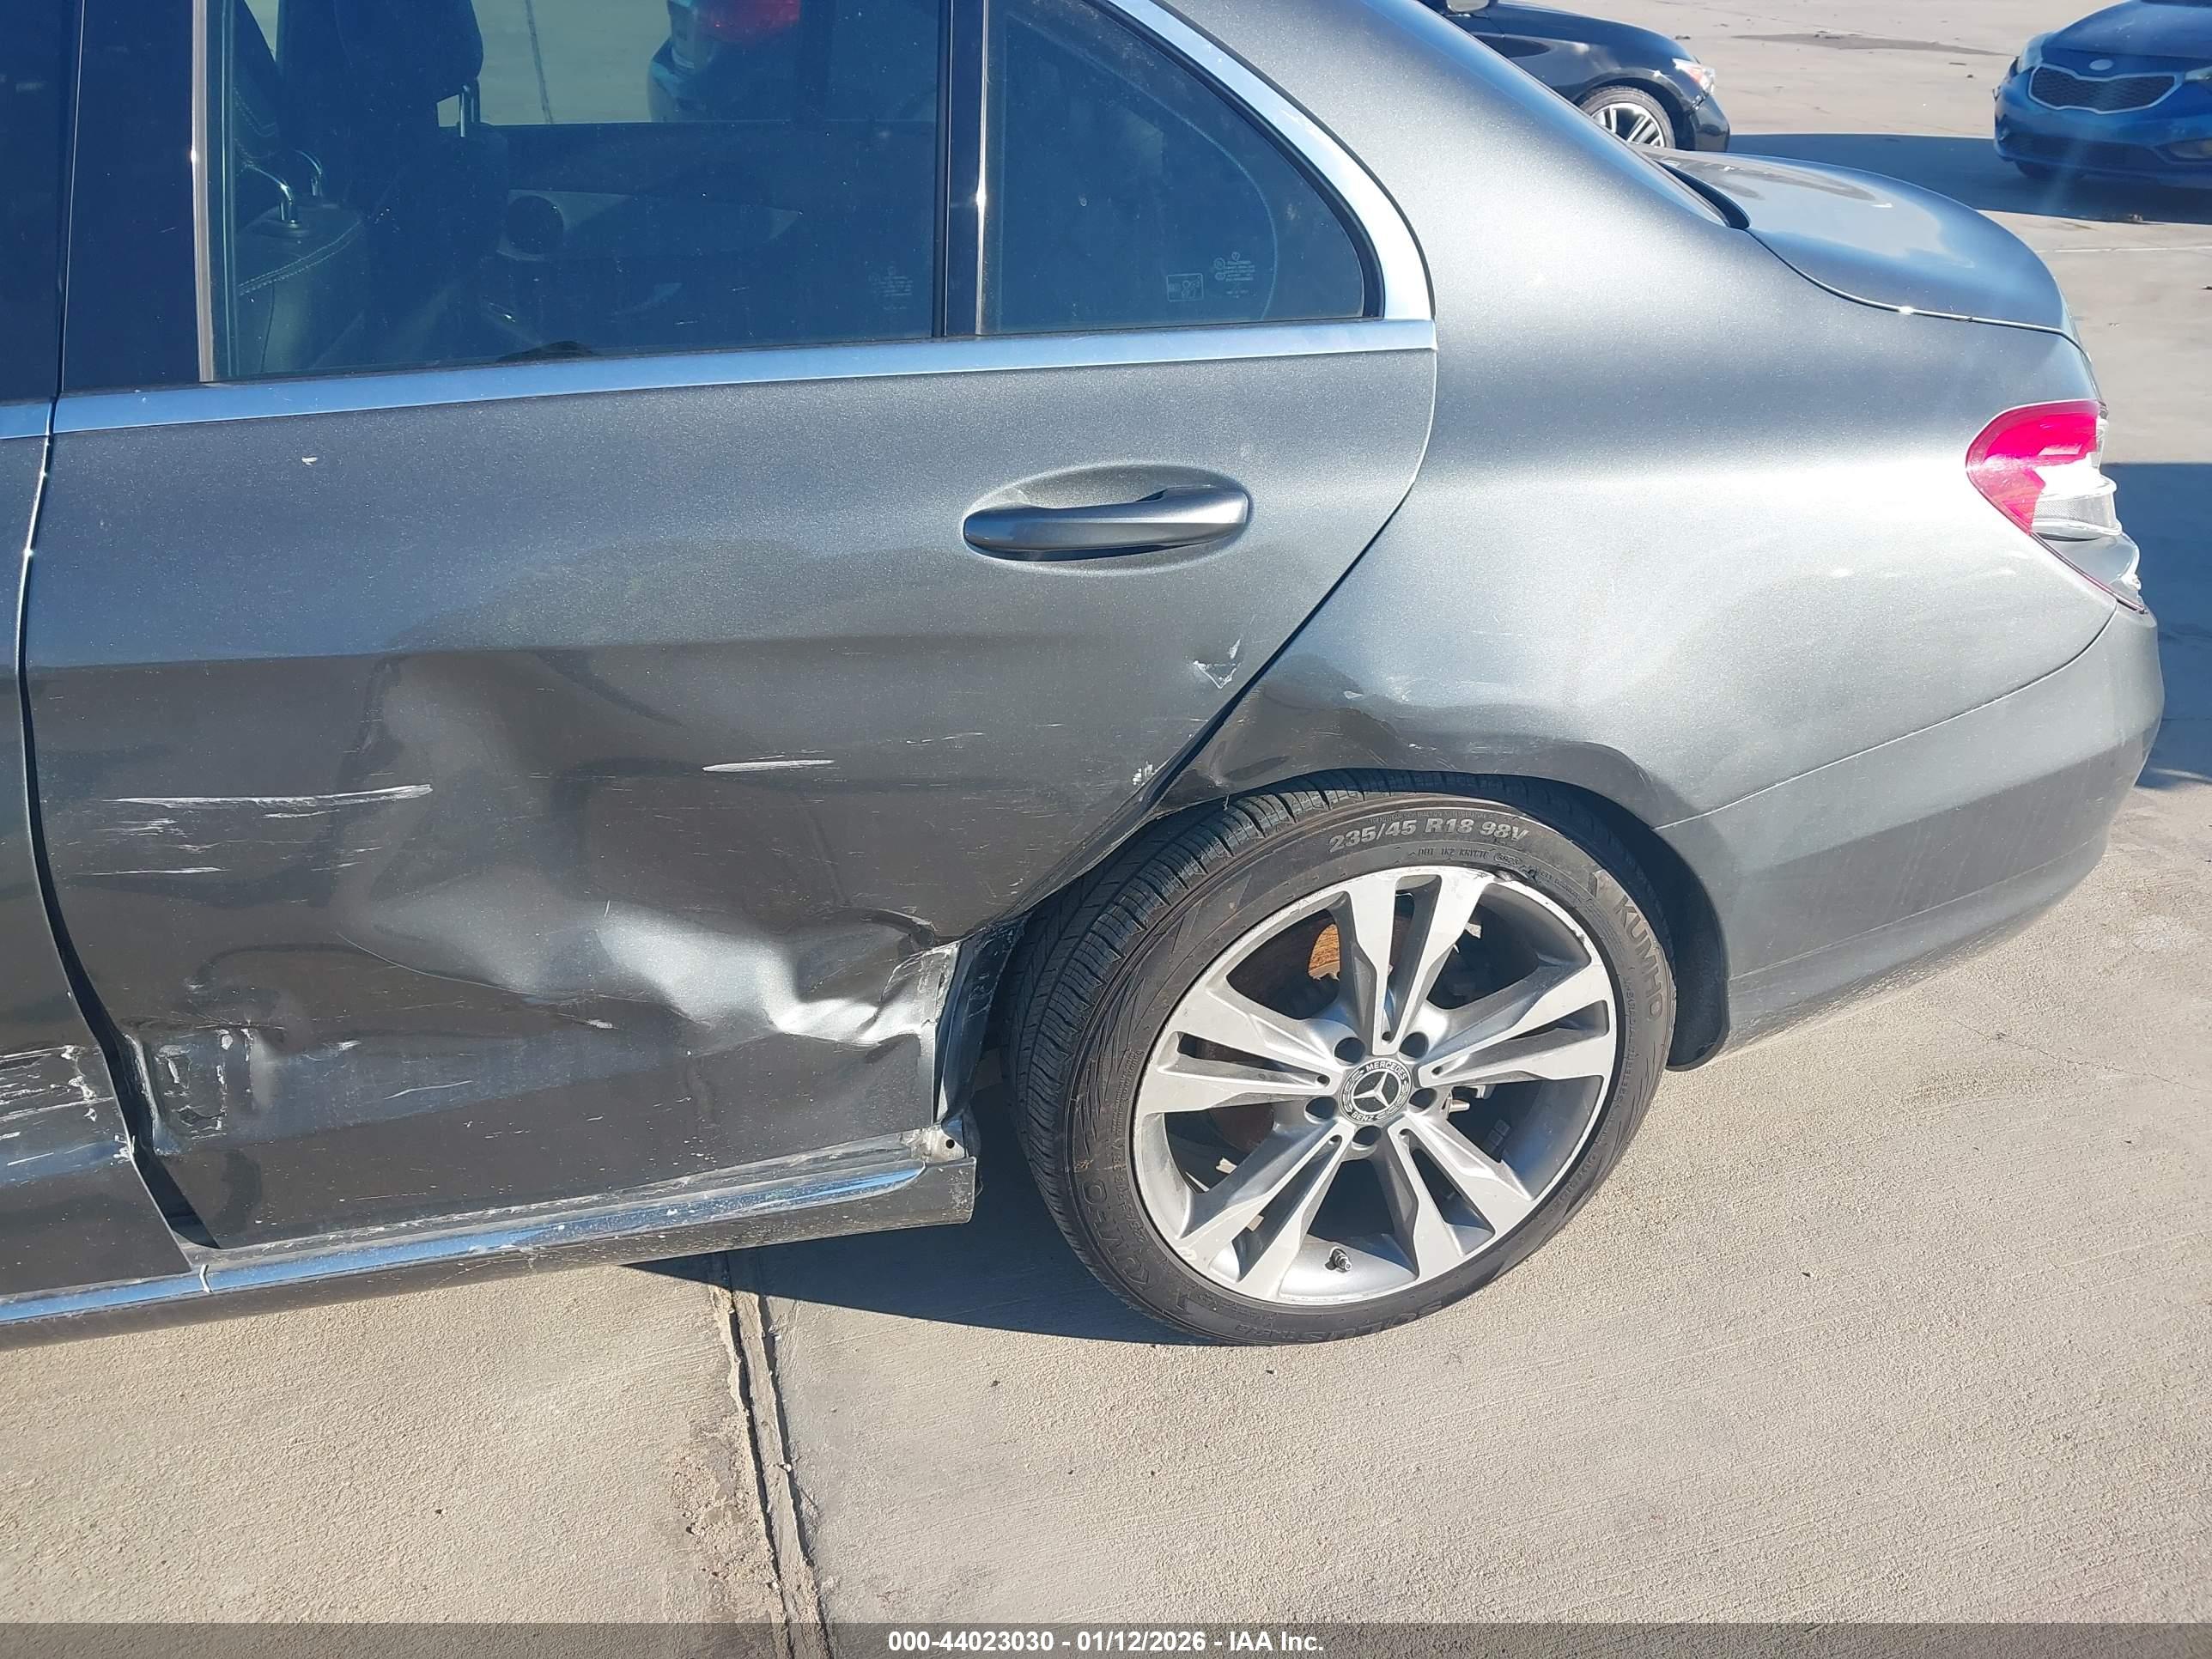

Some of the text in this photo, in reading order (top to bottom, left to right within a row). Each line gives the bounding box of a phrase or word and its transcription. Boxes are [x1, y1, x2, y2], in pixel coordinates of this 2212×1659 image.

[1329, 817, 1529, 853] 235/45 R18 98V
[1613, 894, 1664, 1020] KUMHO
[1365, 1060, 1408, 1080] MERCEDES
[1351, 1111, 1375, 1121] BENZ
